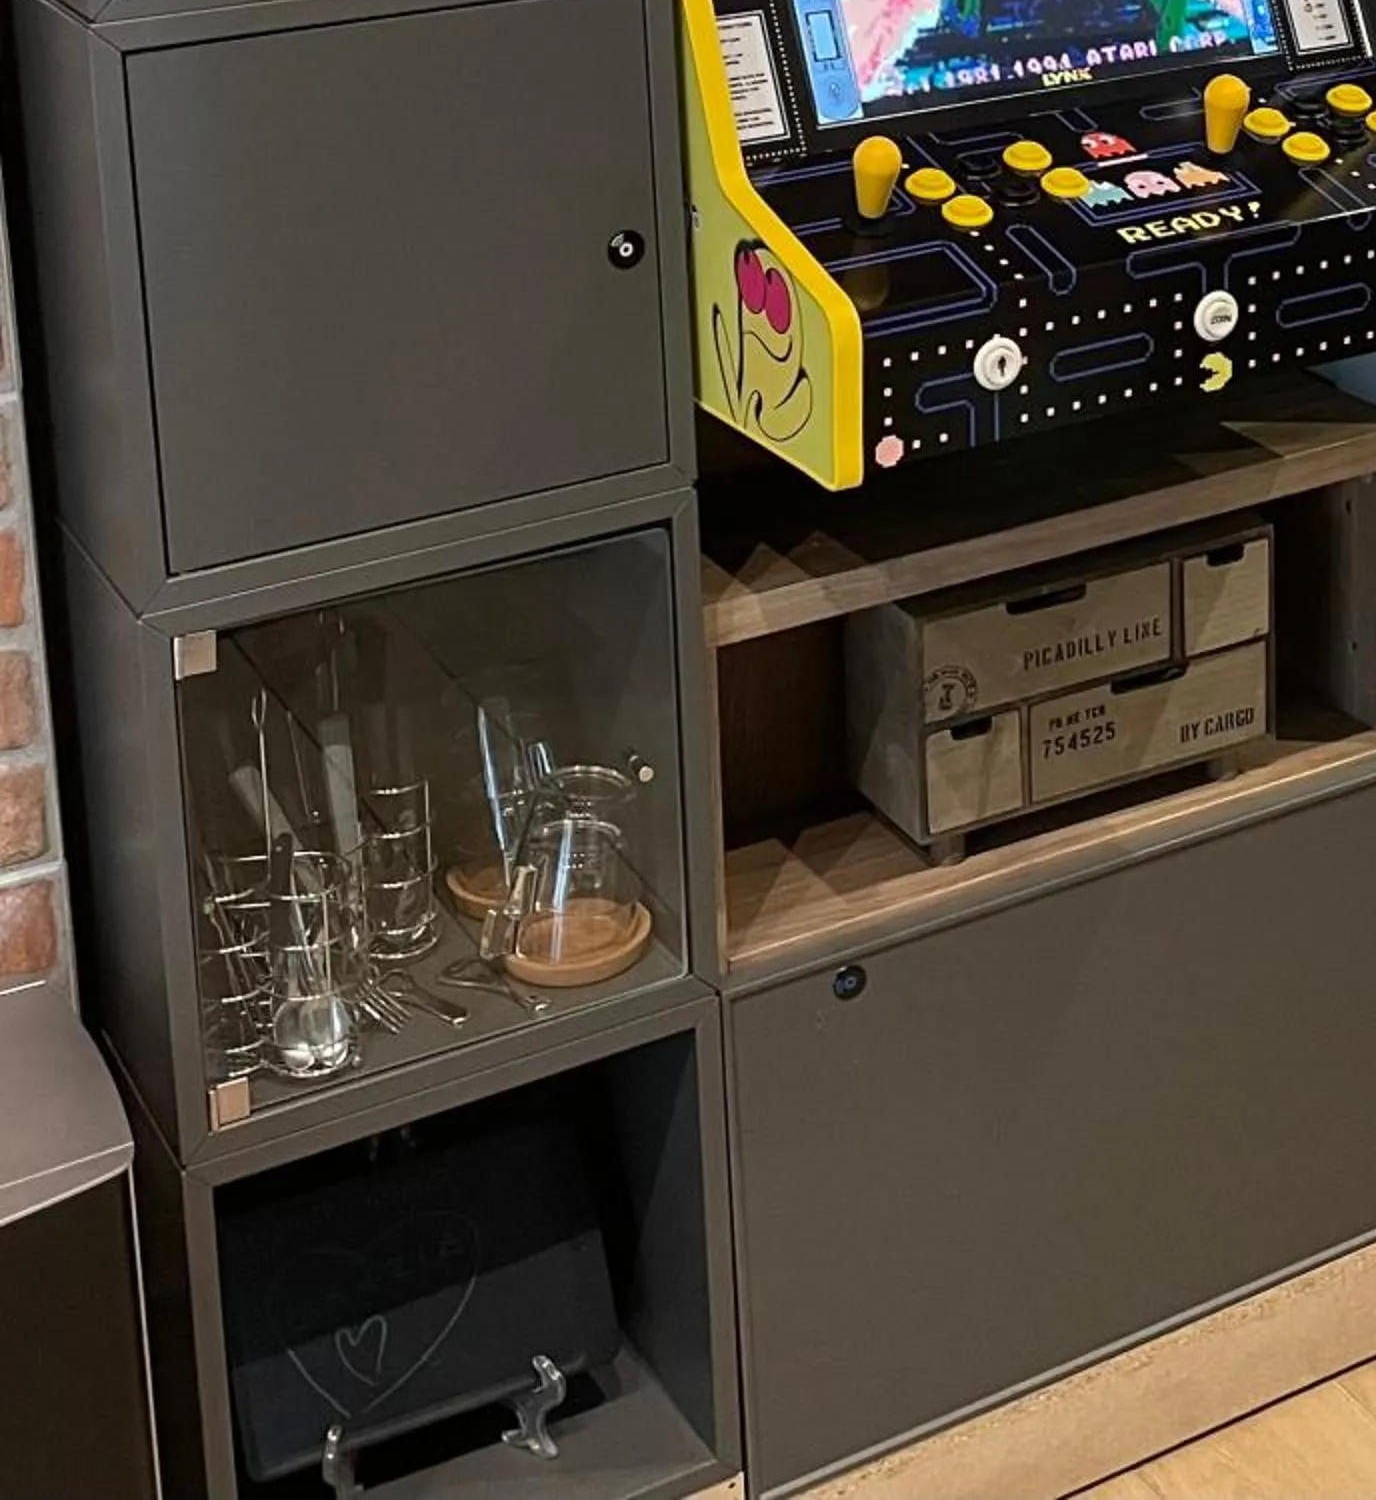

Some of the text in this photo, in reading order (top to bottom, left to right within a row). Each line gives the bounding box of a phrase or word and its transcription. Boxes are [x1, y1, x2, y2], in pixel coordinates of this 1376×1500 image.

[1088, 38, 1158, 68] ATARI
[1042, 66, 1093, 88] LYNX
[1117, 202, 1261, 243] READY!
[1022, 617, 1162, 671] PICADILLY LINE
[1040, 720, 1117, 760] 754525
[1178, 706, 1256, 744] BY CARGO
